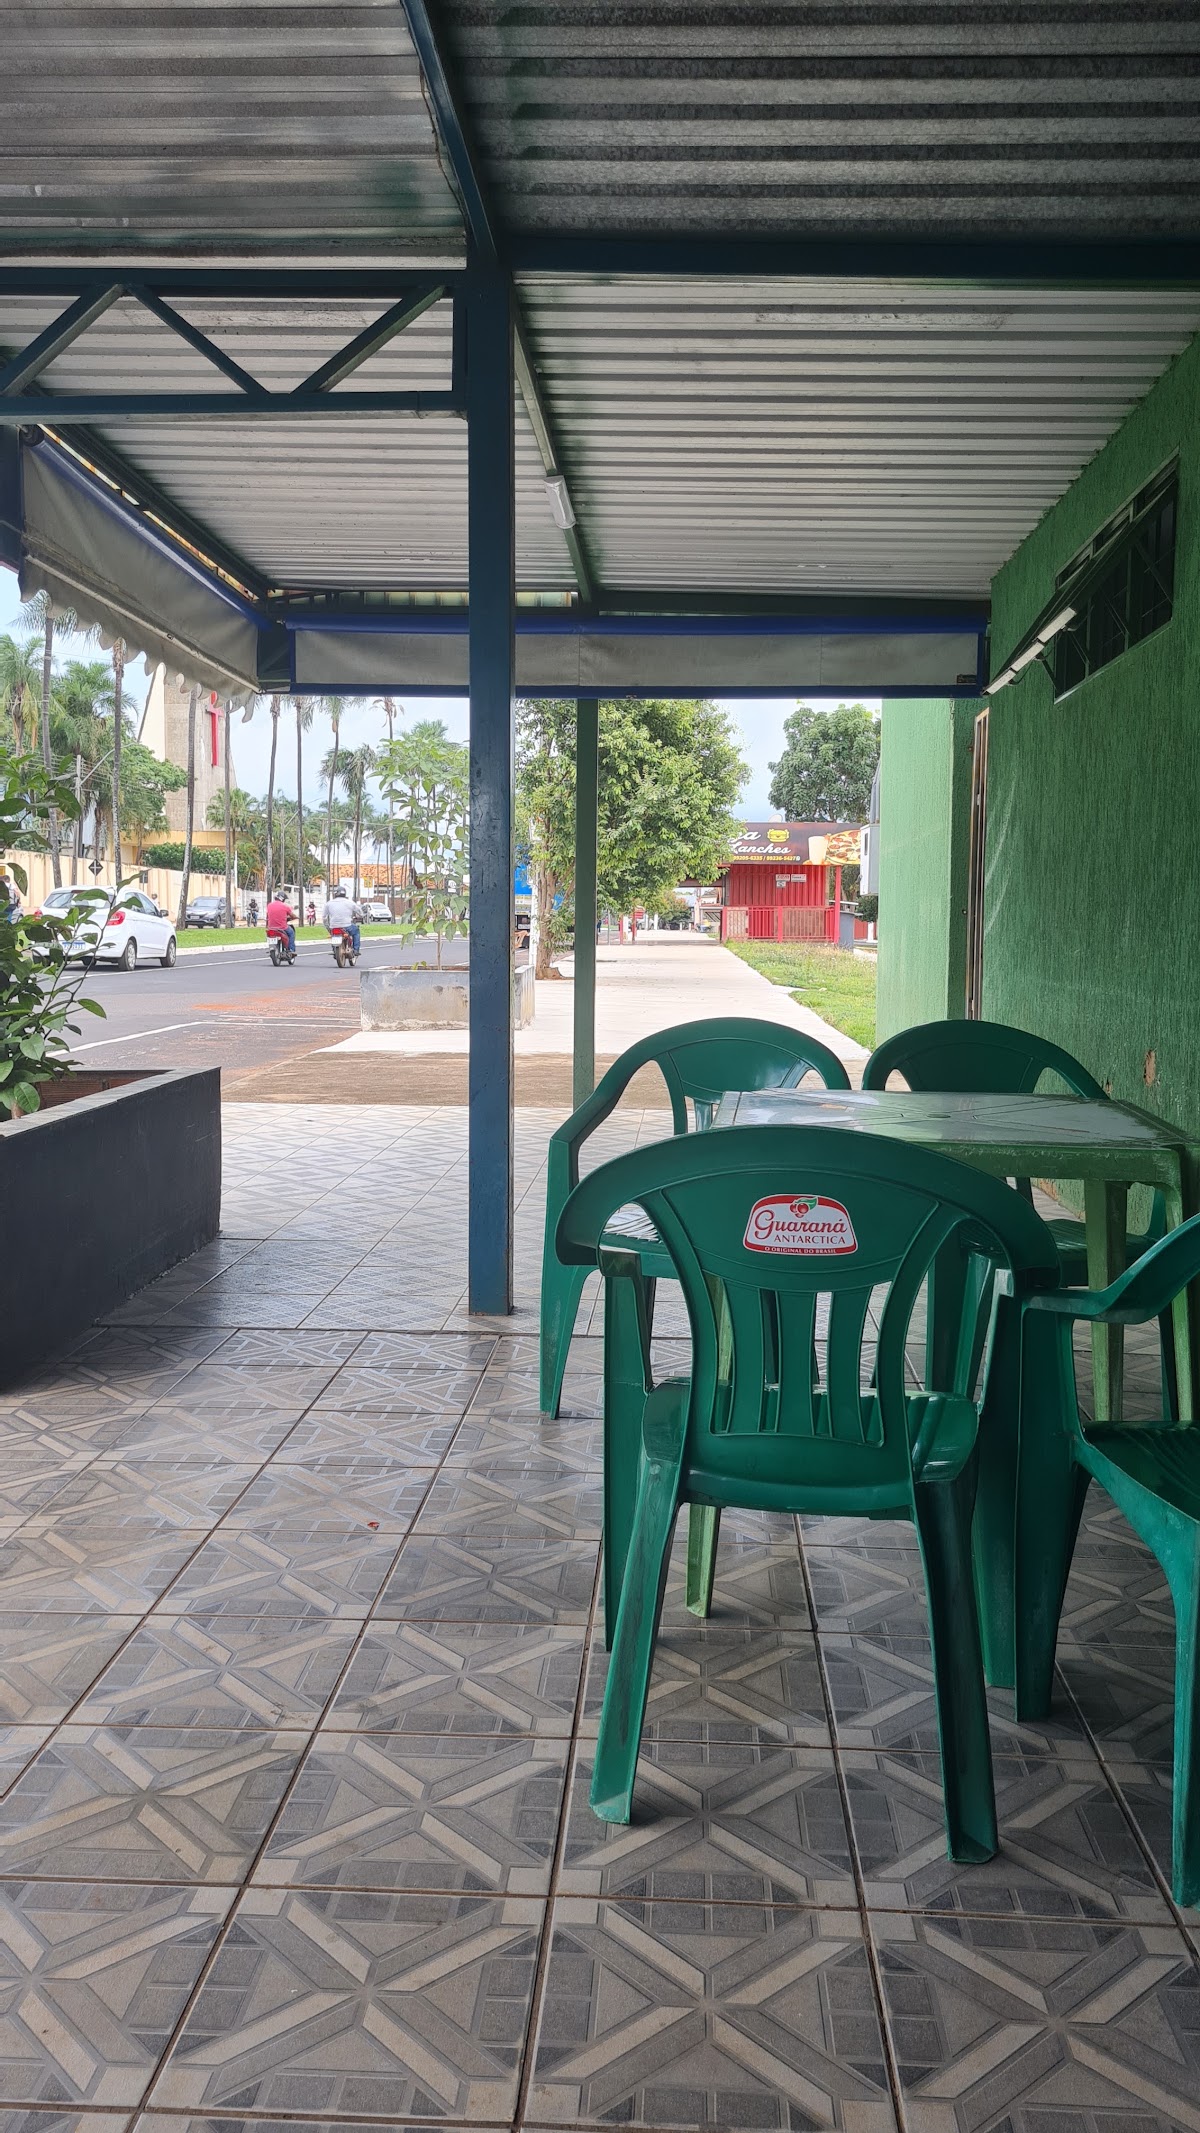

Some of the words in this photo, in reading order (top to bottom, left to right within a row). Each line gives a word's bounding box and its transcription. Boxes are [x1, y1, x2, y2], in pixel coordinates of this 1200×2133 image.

[729, 842, 791, 854] Lanches
[754, 1210, 848, 1240] Guaraná
[774, 1234, 846, 1244] ANTARCTICA
